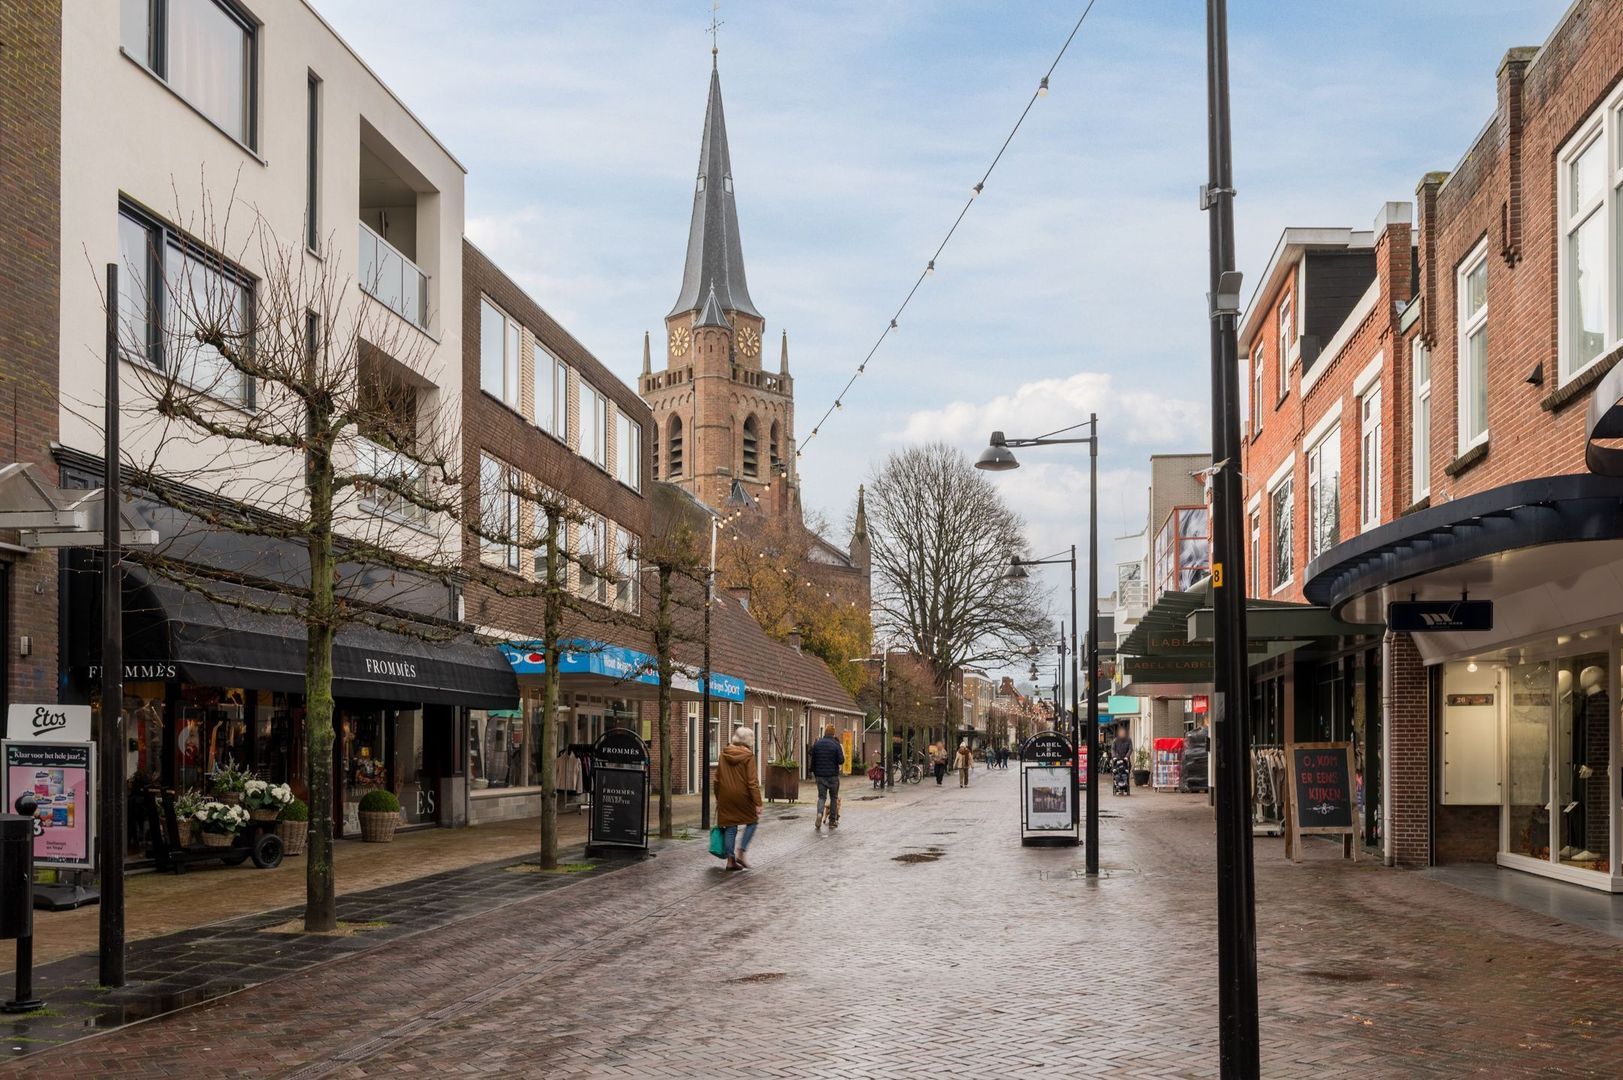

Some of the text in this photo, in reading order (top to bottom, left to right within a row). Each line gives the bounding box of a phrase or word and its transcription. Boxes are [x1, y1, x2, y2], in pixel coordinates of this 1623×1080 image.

[89, 662, 176, 678] FMMÈS
[366, 658, 416, 678] FROMMÈS
[725, 679, 740, 696] Sport
[32, 706, 66, 728] Etos
[45, 751, 54, 759] het
[602, 747, 640, 755] FROMMÈS
[1301, 772, 1313, 784] ER
